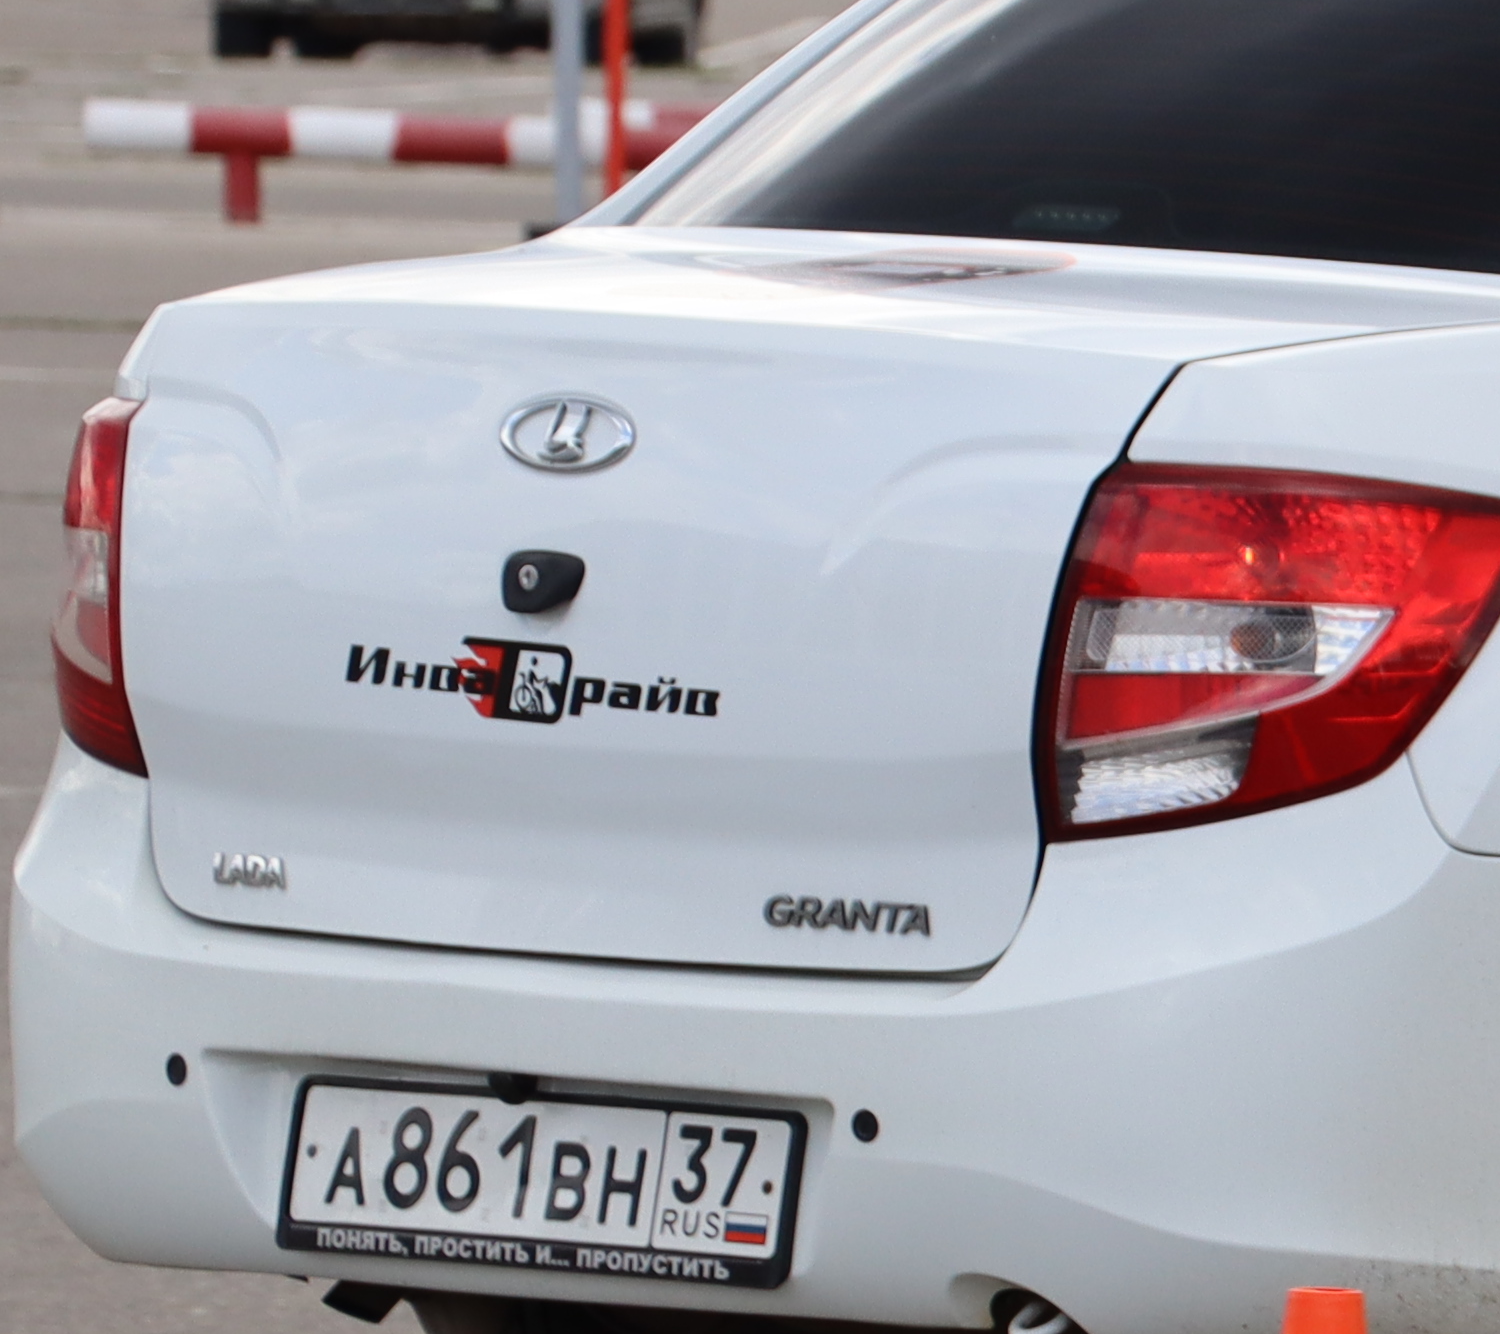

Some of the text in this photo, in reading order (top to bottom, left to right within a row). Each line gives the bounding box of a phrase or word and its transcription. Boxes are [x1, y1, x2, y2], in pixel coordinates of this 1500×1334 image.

[212, 851, 288, 891] LADA
[762, 893, 932, 938] GRANTA
[671, 1123, 758, 1208] 37
[659, 1208, 721, 1240] RUS
[316, 1226, 409, 1259] ПОНЯТЬ,
[413, 1234, 530, 1264] ПРОСТИТЬ
[576, 1247, 730, 1281] ПРОПУСТИТЬ
